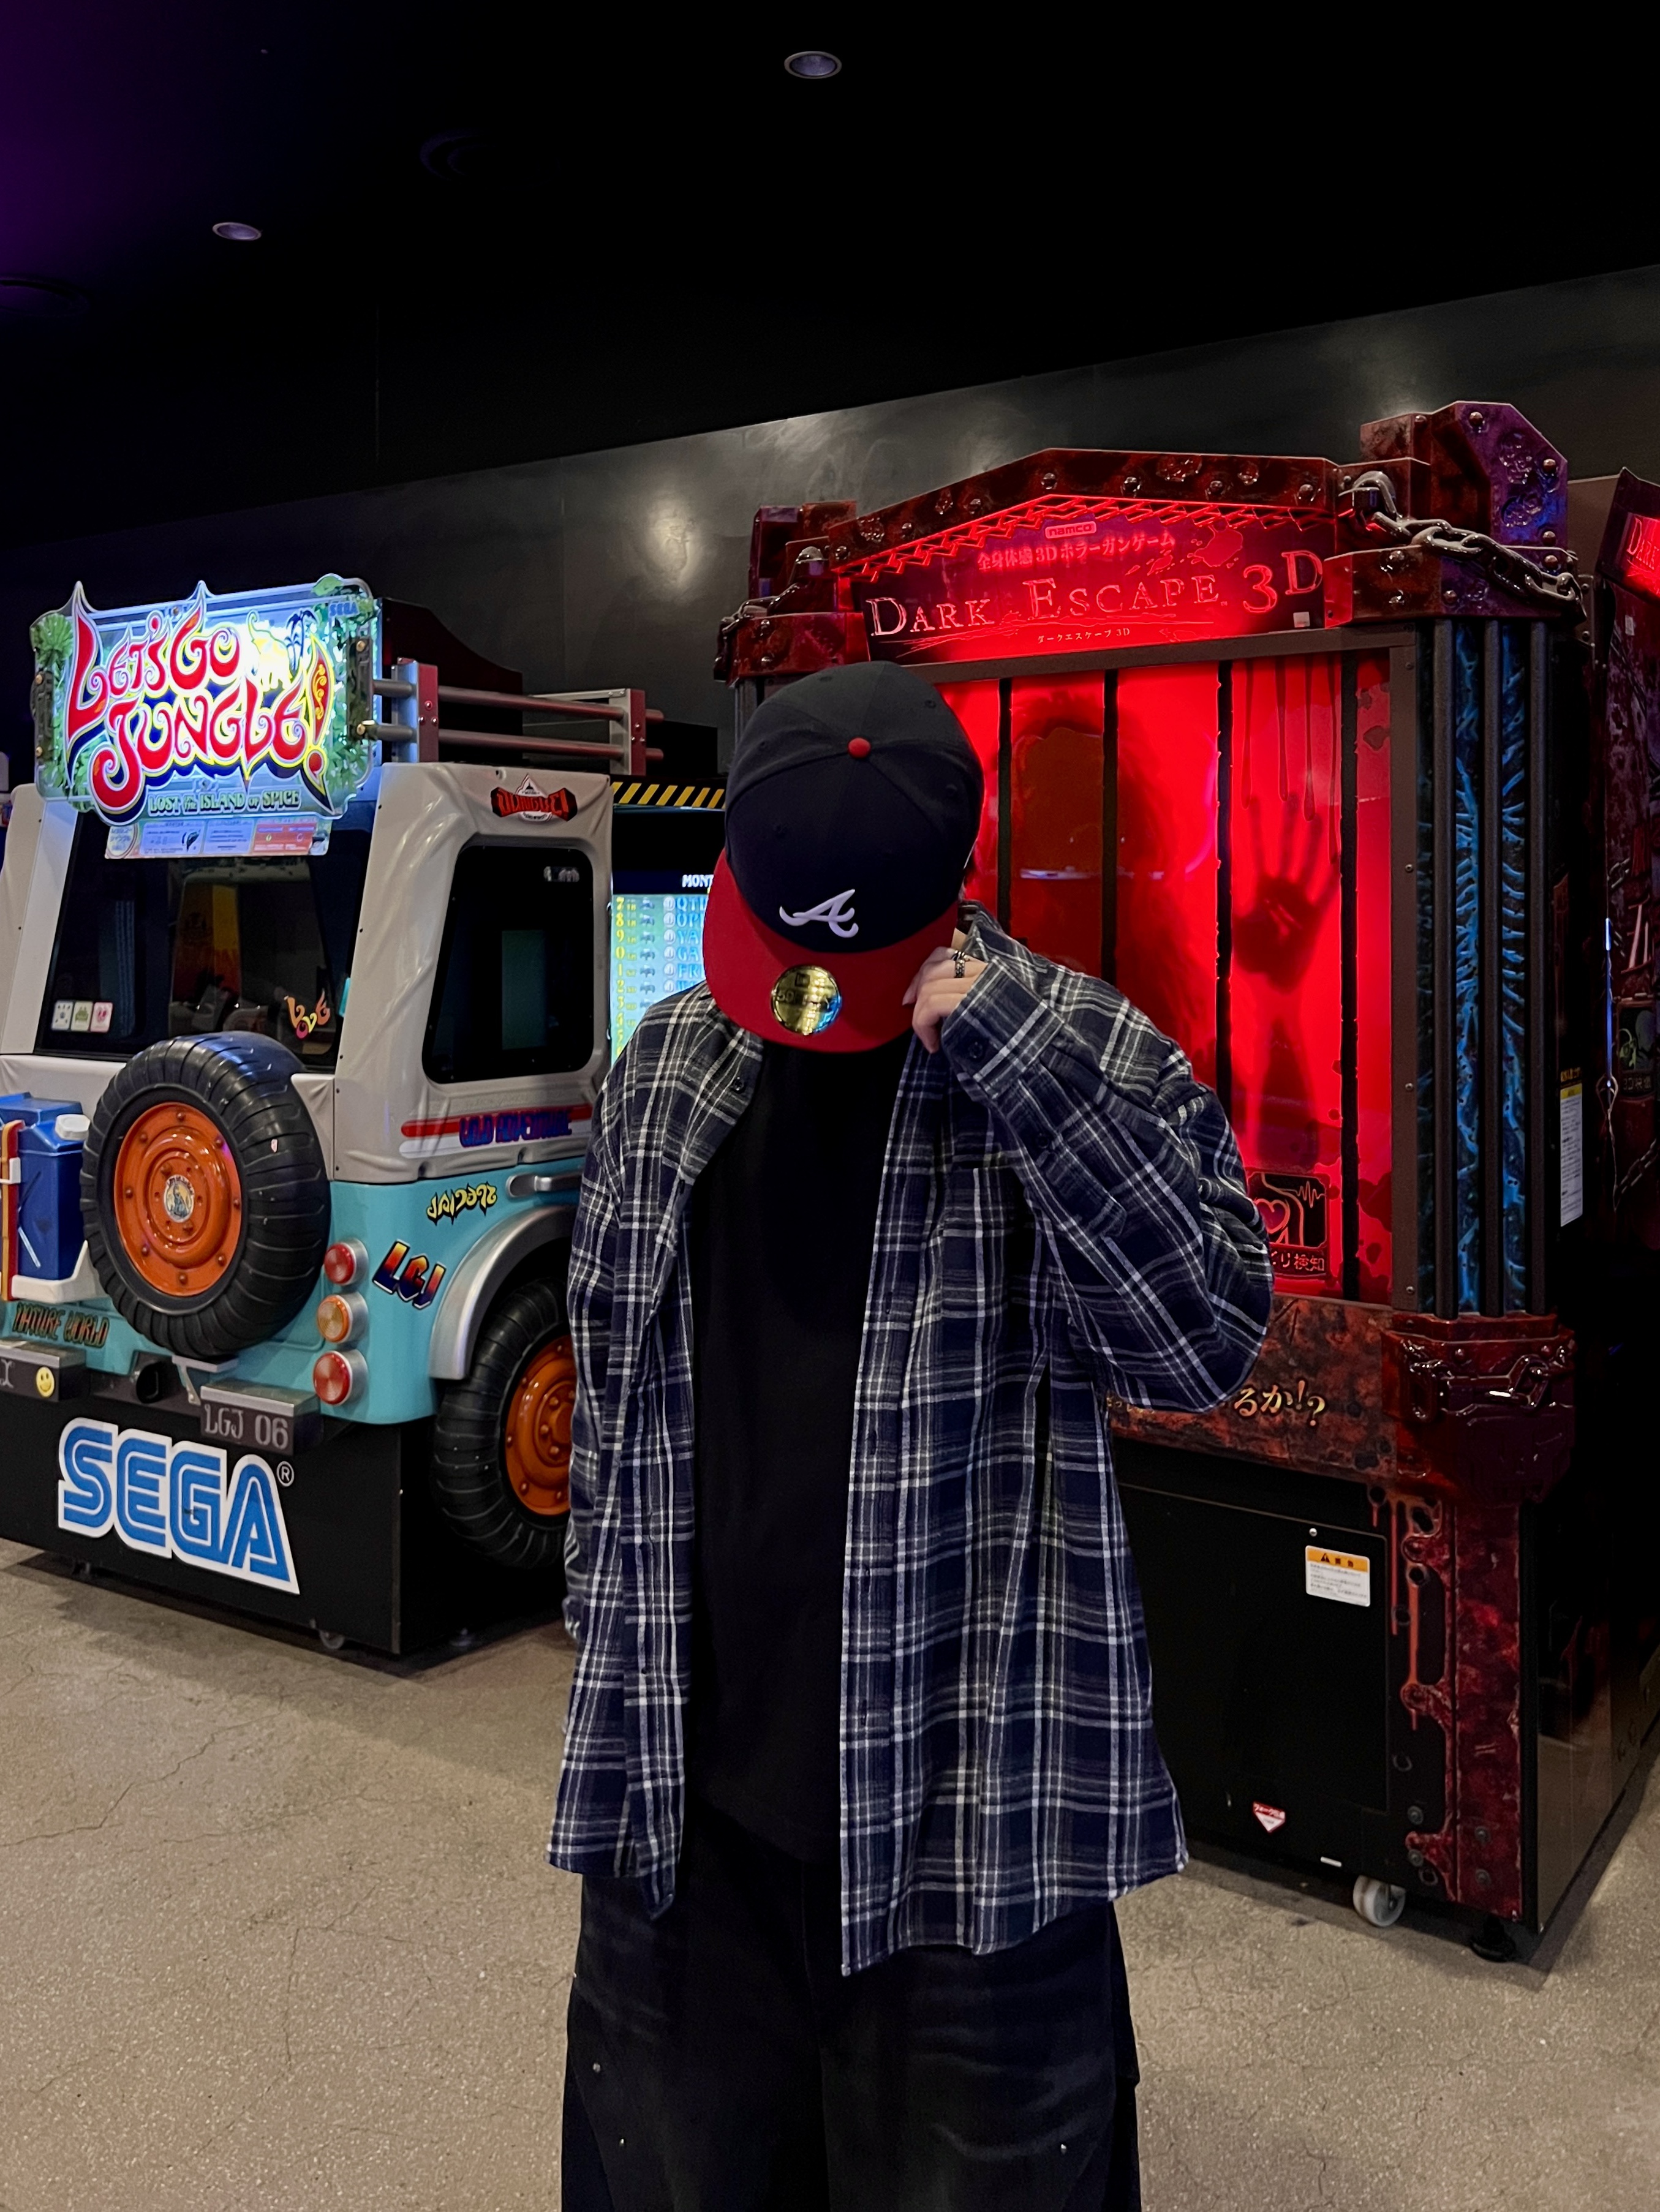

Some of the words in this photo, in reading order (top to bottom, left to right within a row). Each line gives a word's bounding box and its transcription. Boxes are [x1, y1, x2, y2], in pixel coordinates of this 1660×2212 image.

[1049, 523, 1092, 536] namco
[866, 597, 995, 636] DARK
[1022, 574, 1221, 620] ESCAPE
[1242, 550, 1323, 612] 3D
[149, 796, 181, 813] LOST
[200, 792, 245, 811] ISLAND
[263, 790, 300, 807] SPICE
[204, 1404, 244, 1439] LGJ
[254, 1414, 289, 1450] 06
[58, 1417, 300, 1595] SEGA
